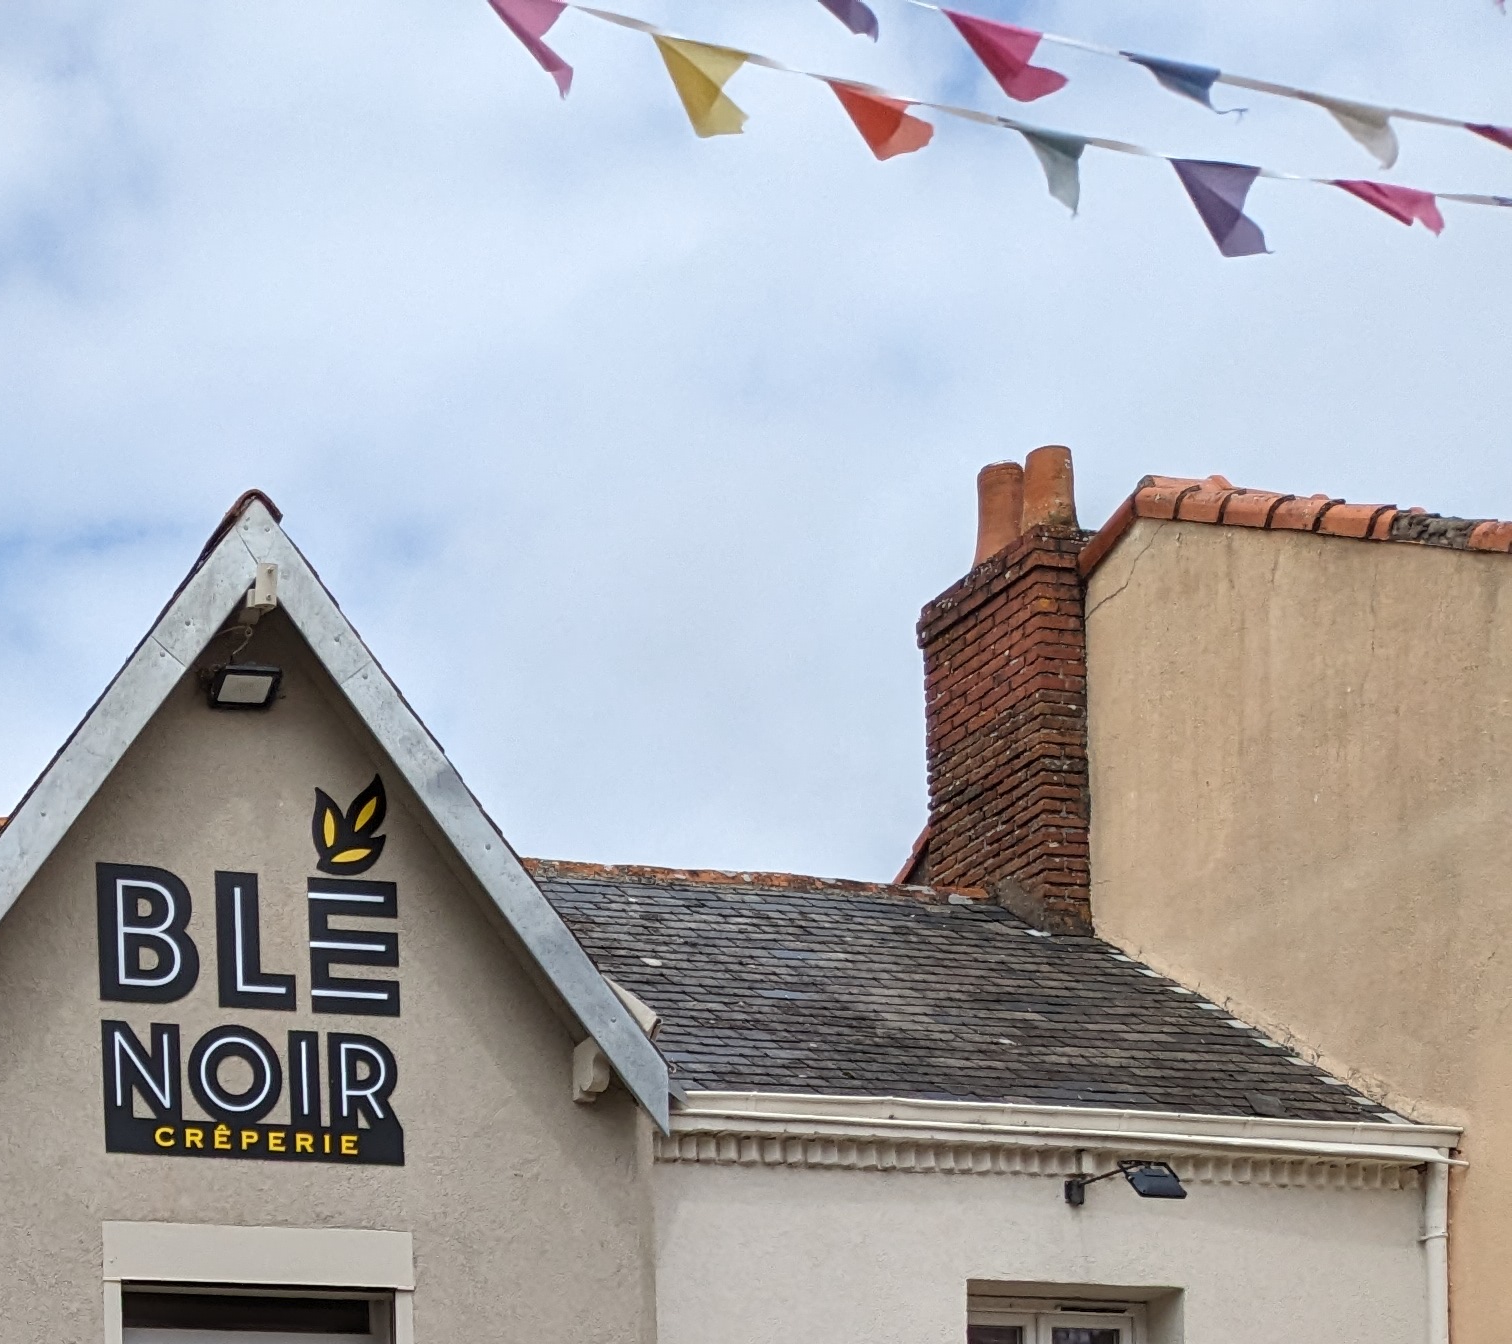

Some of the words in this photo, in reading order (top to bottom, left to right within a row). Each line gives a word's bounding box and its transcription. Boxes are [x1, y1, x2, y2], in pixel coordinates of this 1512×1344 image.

[96, 774, 400, 1016] BLÉ
[101, 1020, 401, 1126] NOIR
[155, 1124, 359, 1155] CRÊPERIE
